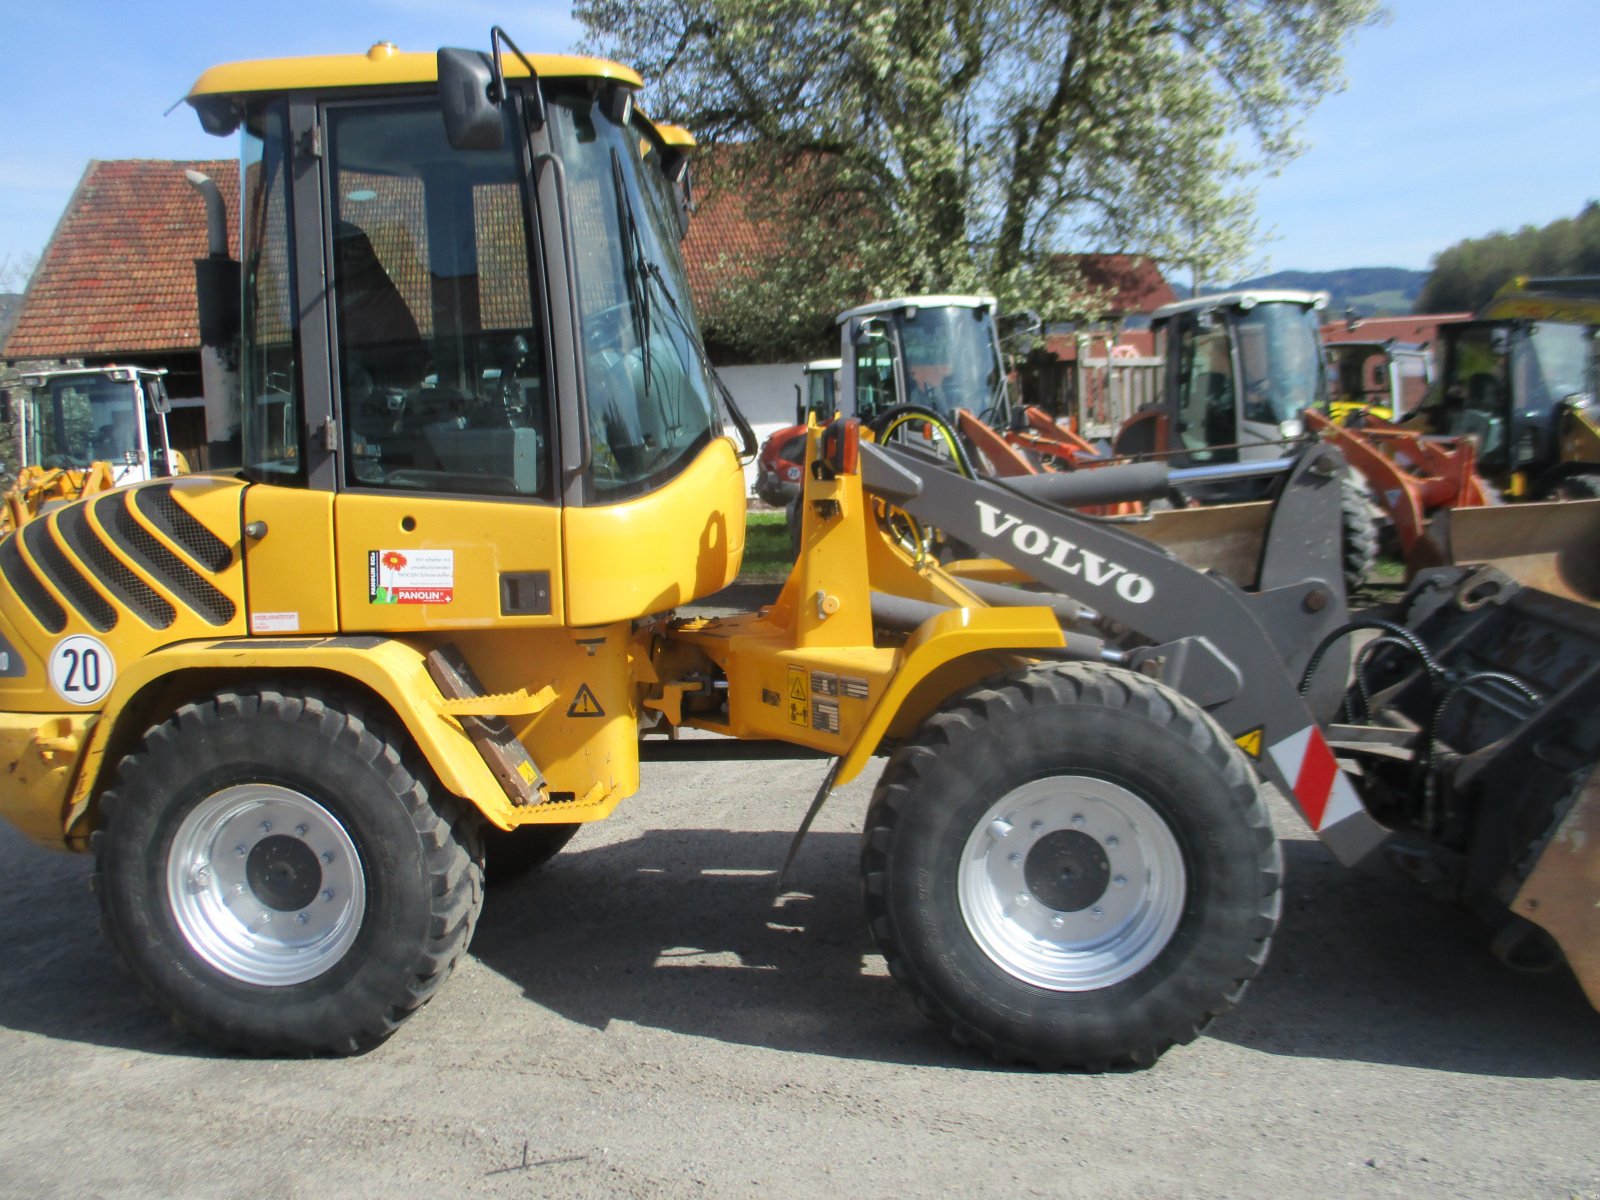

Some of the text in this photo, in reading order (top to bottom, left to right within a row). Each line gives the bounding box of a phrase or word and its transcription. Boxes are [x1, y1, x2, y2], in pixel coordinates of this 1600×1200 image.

[975, 500, 1154, 604] VOLVO
[399, 591, 440, 600] PANOLIN
[63, 648, 100, 692] 20
